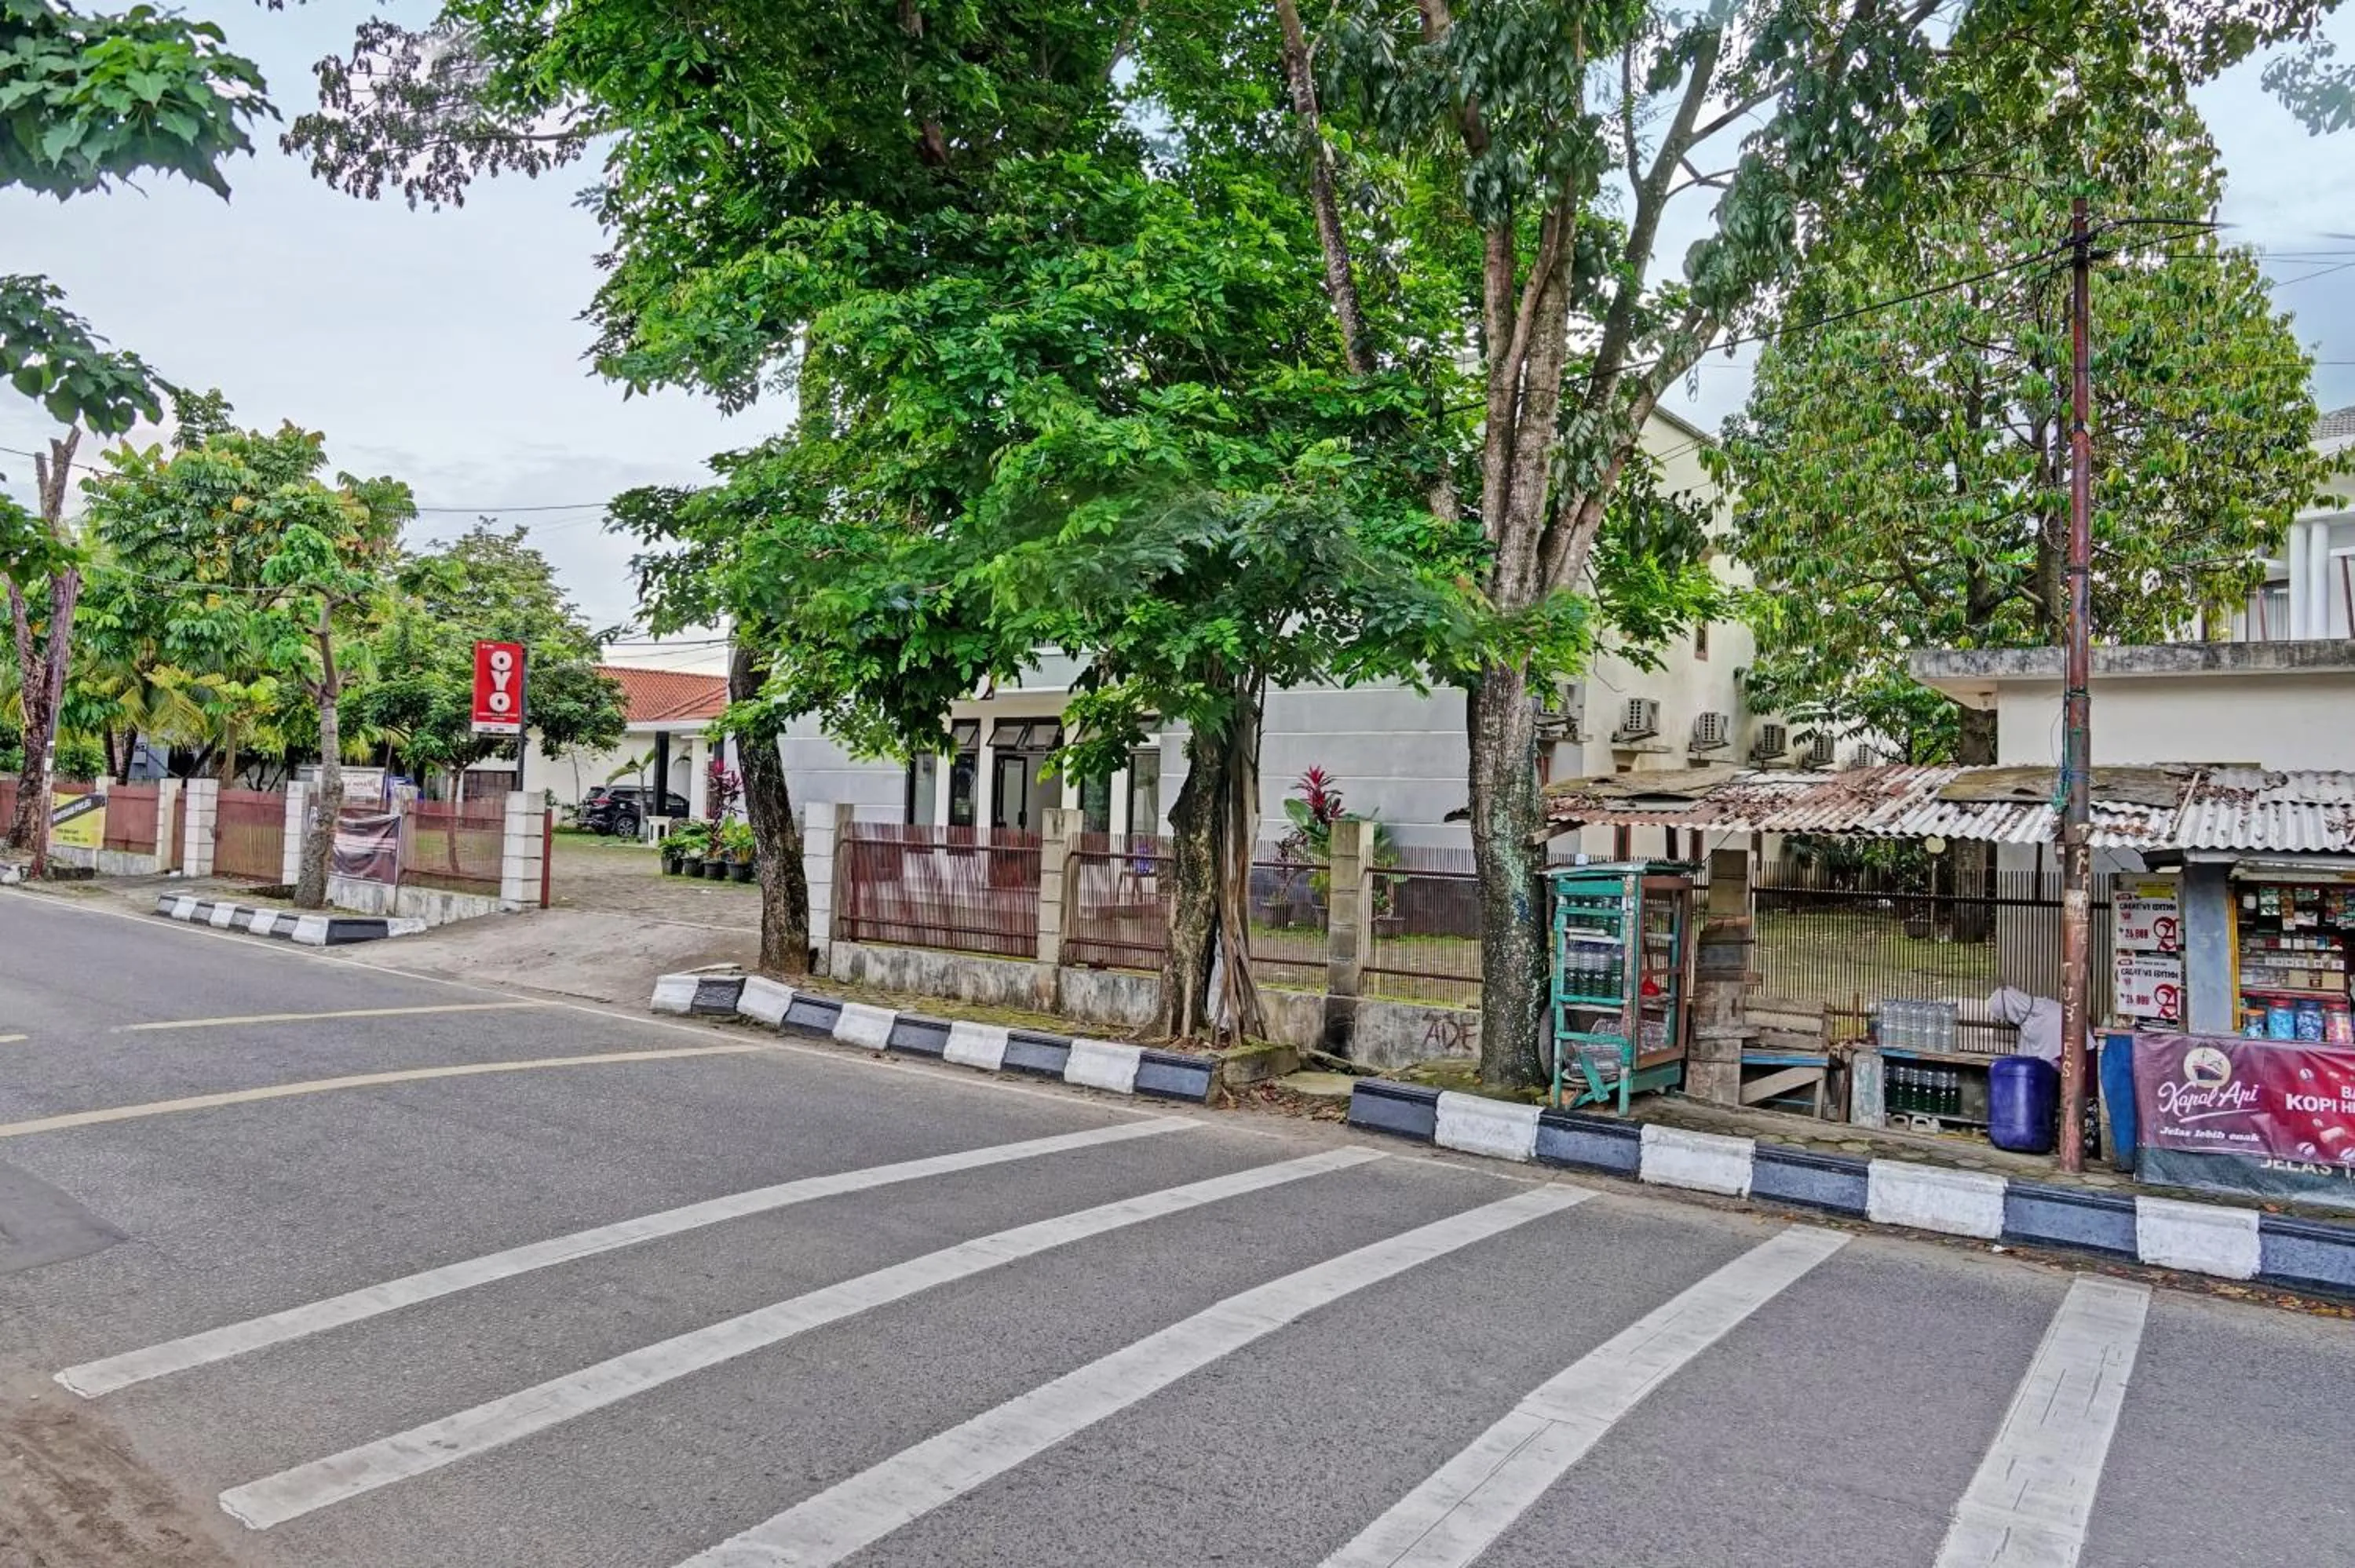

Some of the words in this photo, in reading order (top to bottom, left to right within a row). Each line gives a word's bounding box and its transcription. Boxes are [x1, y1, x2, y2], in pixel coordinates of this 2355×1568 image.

[490, 651, 512, 713] OYO
[1422, 1021, 1477, 1050] ADE
[2158, 1081, 2219, 1116] Kapal
[2216, 1081, 2259, 1109] Api
[2285, 1093, 2337, 1113] KOPI
